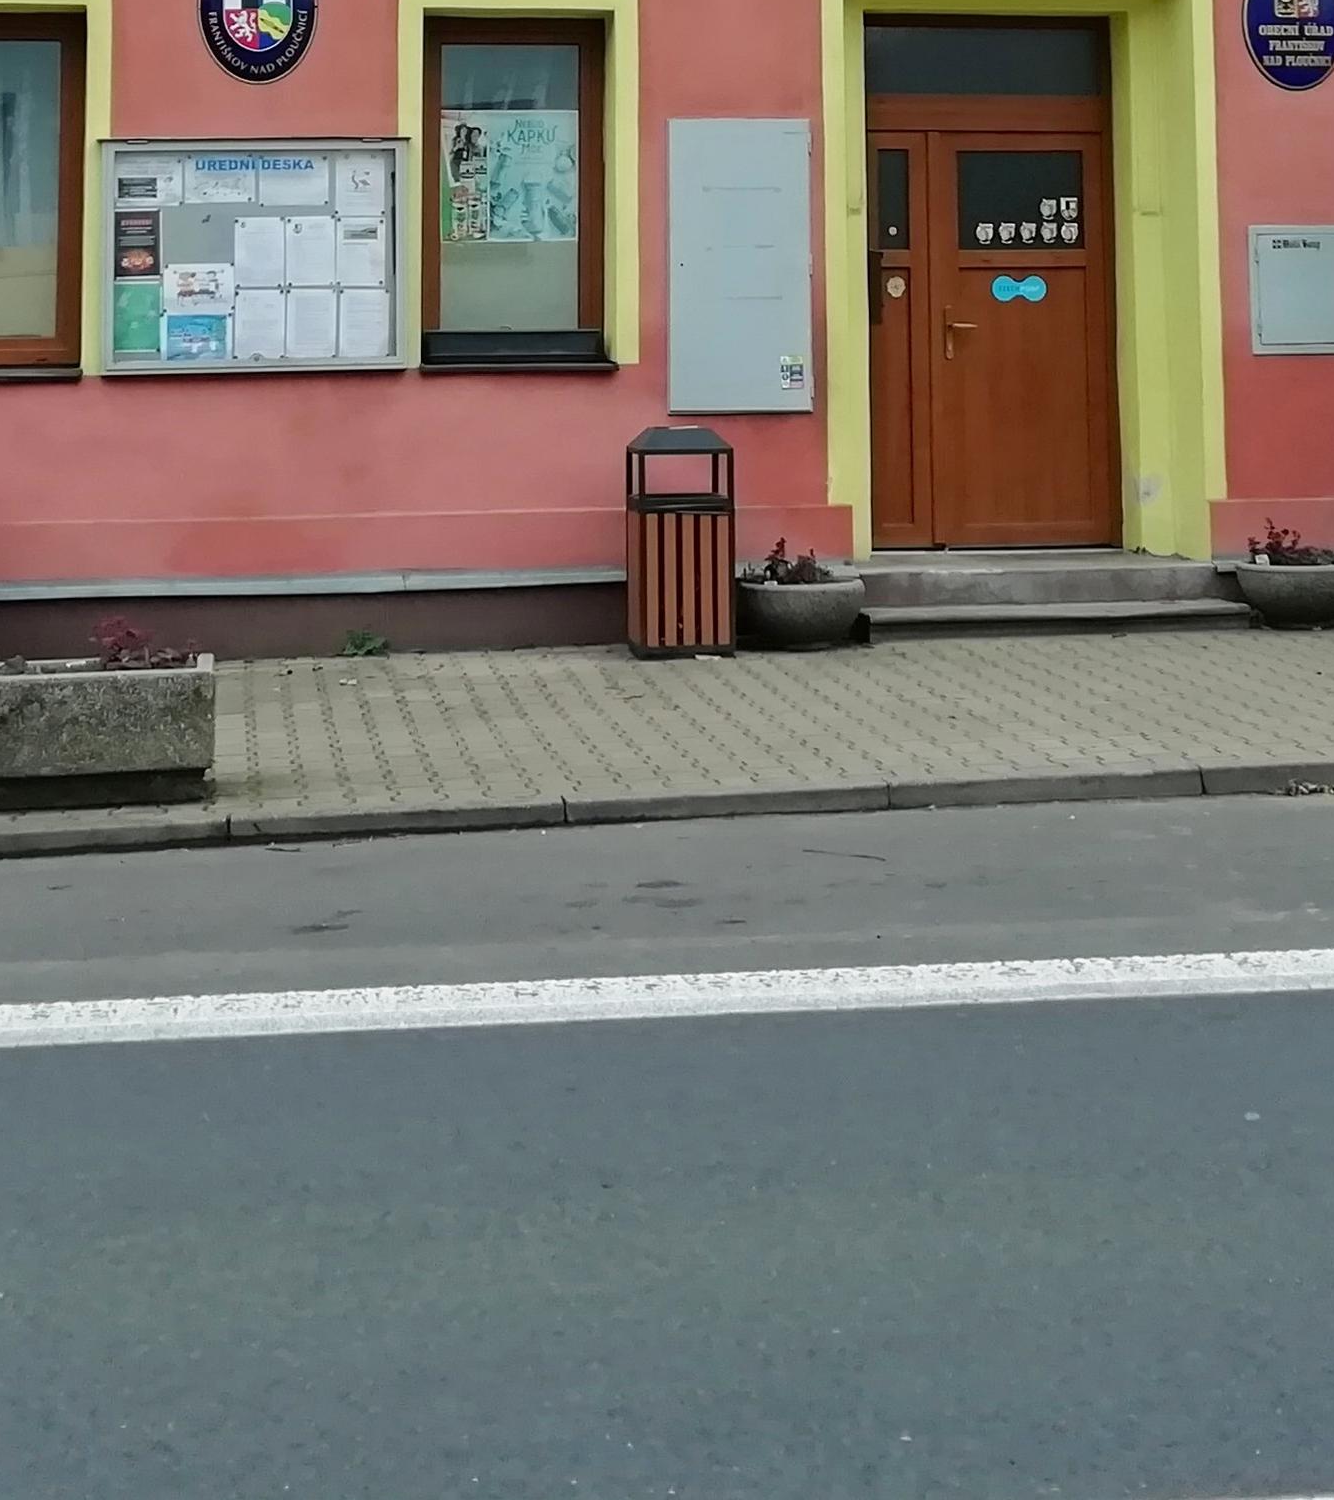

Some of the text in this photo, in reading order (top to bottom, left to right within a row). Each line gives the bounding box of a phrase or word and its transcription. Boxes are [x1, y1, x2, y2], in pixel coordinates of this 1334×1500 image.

[1258, 21, 1300, 36] OBECNÍ
[208, 9, 308, 75] FRANTIŠKOV NAD PLOUČNICÍ
[1262, 55, 1283, 66] NAD
[261, 159, 315, 171] DESKA
